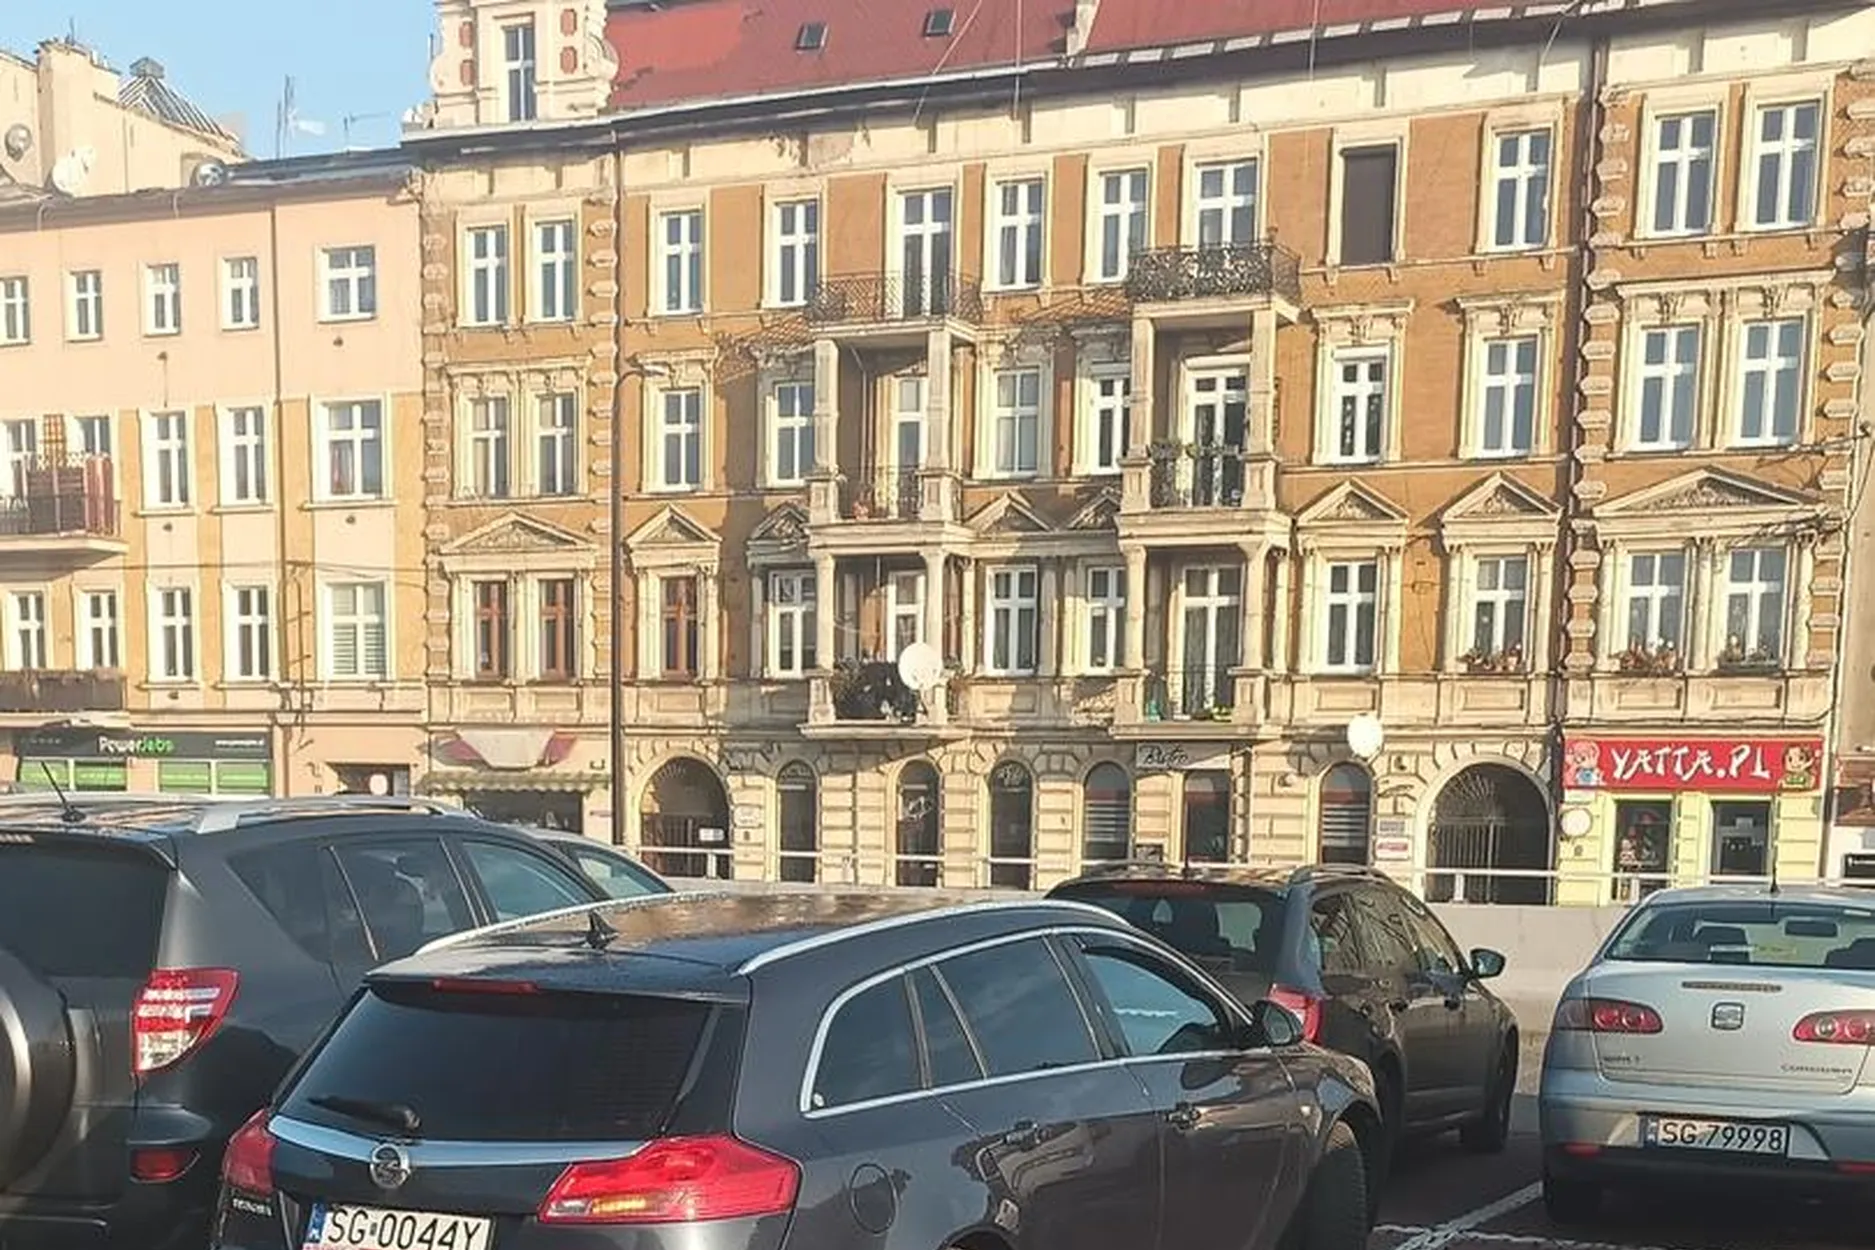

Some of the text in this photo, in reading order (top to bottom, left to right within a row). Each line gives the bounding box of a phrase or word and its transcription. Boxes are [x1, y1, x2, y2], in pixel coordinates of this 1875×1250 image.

[1611, 743, 1770, 781] YATTA.PL
[1661, 1121, 1783, 1151] SG 79998
[328, 1208, 369, 1245] SG
